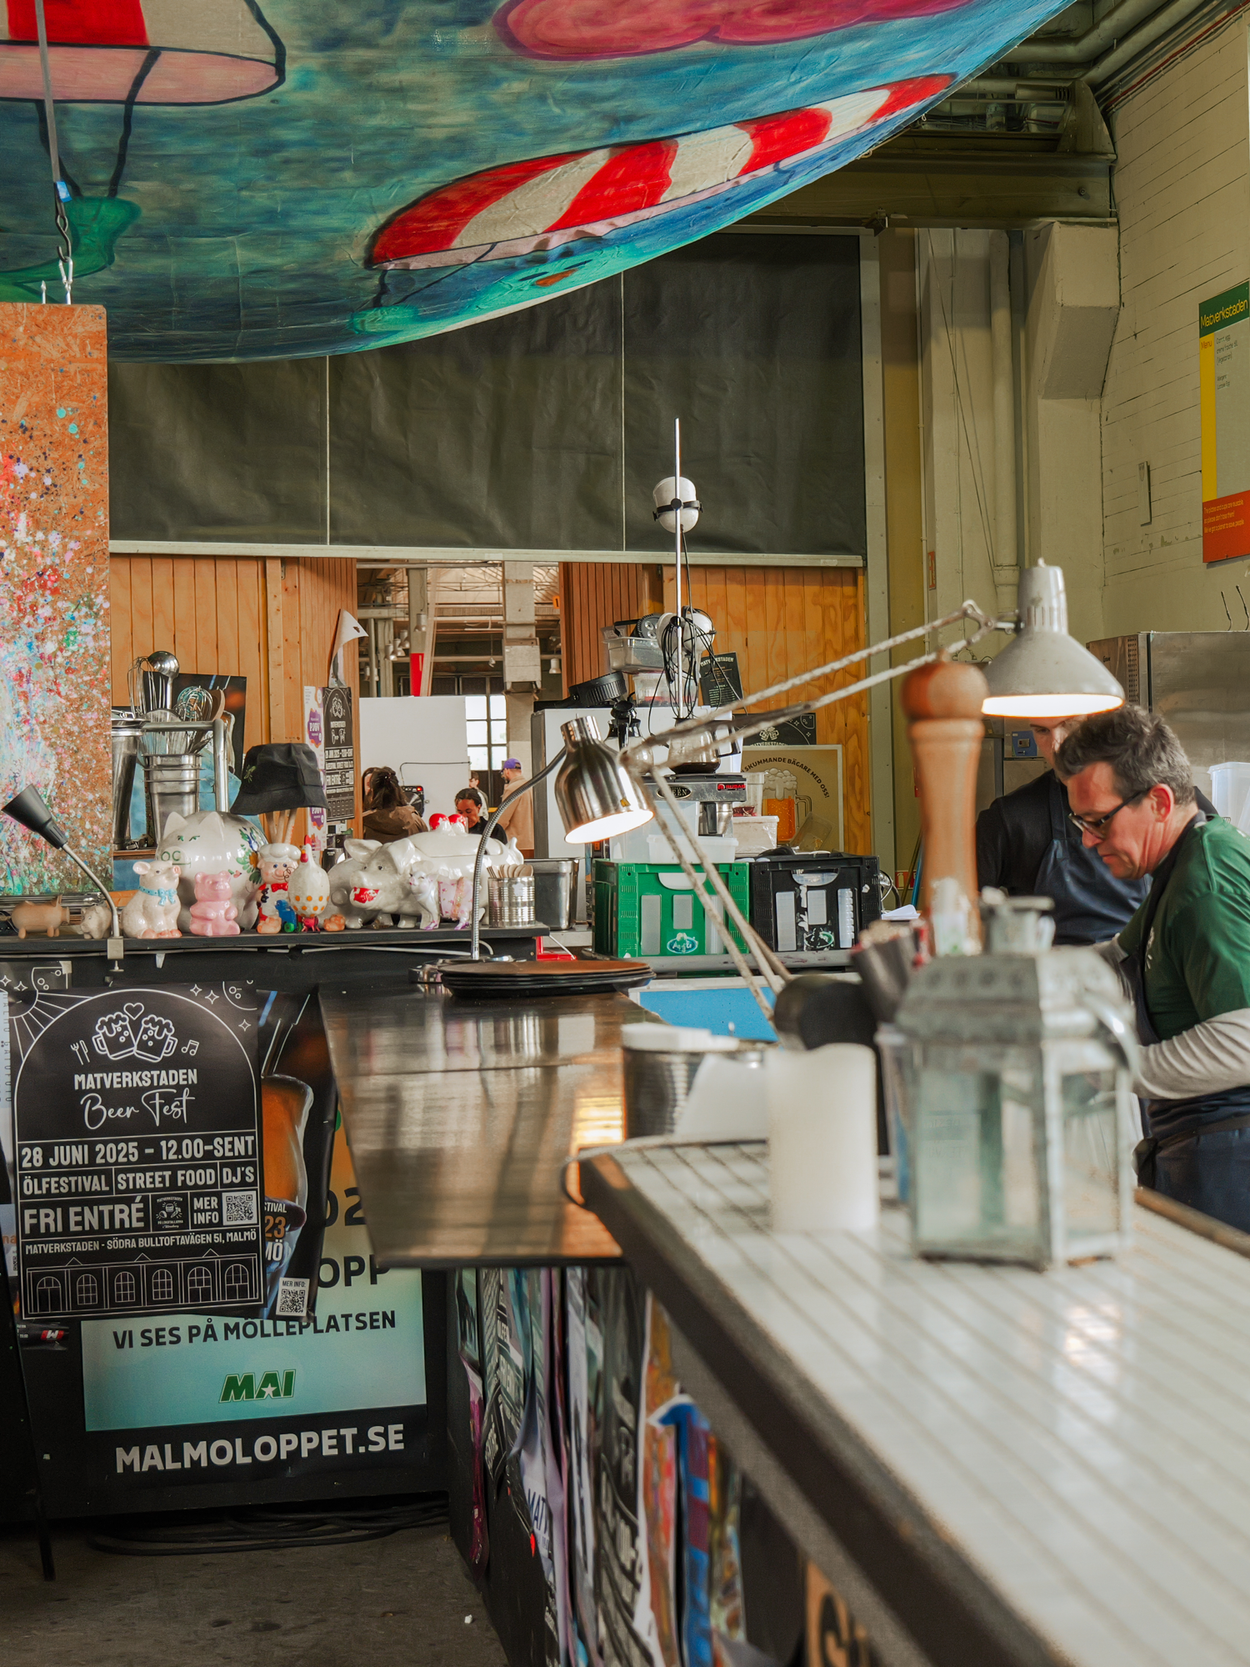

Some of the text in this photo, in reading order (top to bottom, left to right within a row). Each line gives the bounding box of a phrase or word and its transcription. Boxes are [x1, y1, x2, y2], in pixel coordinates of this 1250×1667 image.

[1201, 299, 1248, 328] Matverkstaden
[744, 756, 786, 773] SKUMMANDE
[787, 757, 812, 774] BÄGARE
[810, 771, 822, 784] MED
[74, 1068, 198, 1091] MATVERKSTADEN
[80, 1087, 196, 1130] Beer Fest
[21, 1146, 43, 1168] 28
[48, 1144, 89, 1166] JUNI
[95, 1141, 139, 1164] 2025
[23, 1175, 110, 1196] ÖLFESTIVAL
[117, 1168, 216, 1190] STREET FOOD
[222, 1166, 255, 1184] DJ'S
[24, 1195, 145, 1234] FRI ENTRÉ
[193, 1196, 219, 1210] MER
[193, 1211, 220, 1225] INFO
[25, 1240, 100, 1255] MATVERKSTADEN
[107, 1237, 136, 1250] SÖDRA
[138, 1232, 212, 1248] BULLTOFTAVÄGEN
[226, 1228, 257, 1243] MALMÖ
[113, 1310, 396, 1349] VI SES PÅ MÖLLEPLATSEN
[218, 1368, 296, 1404] MAI
[115, 1423, 405, 1474] MALMOLOPPET.SE
